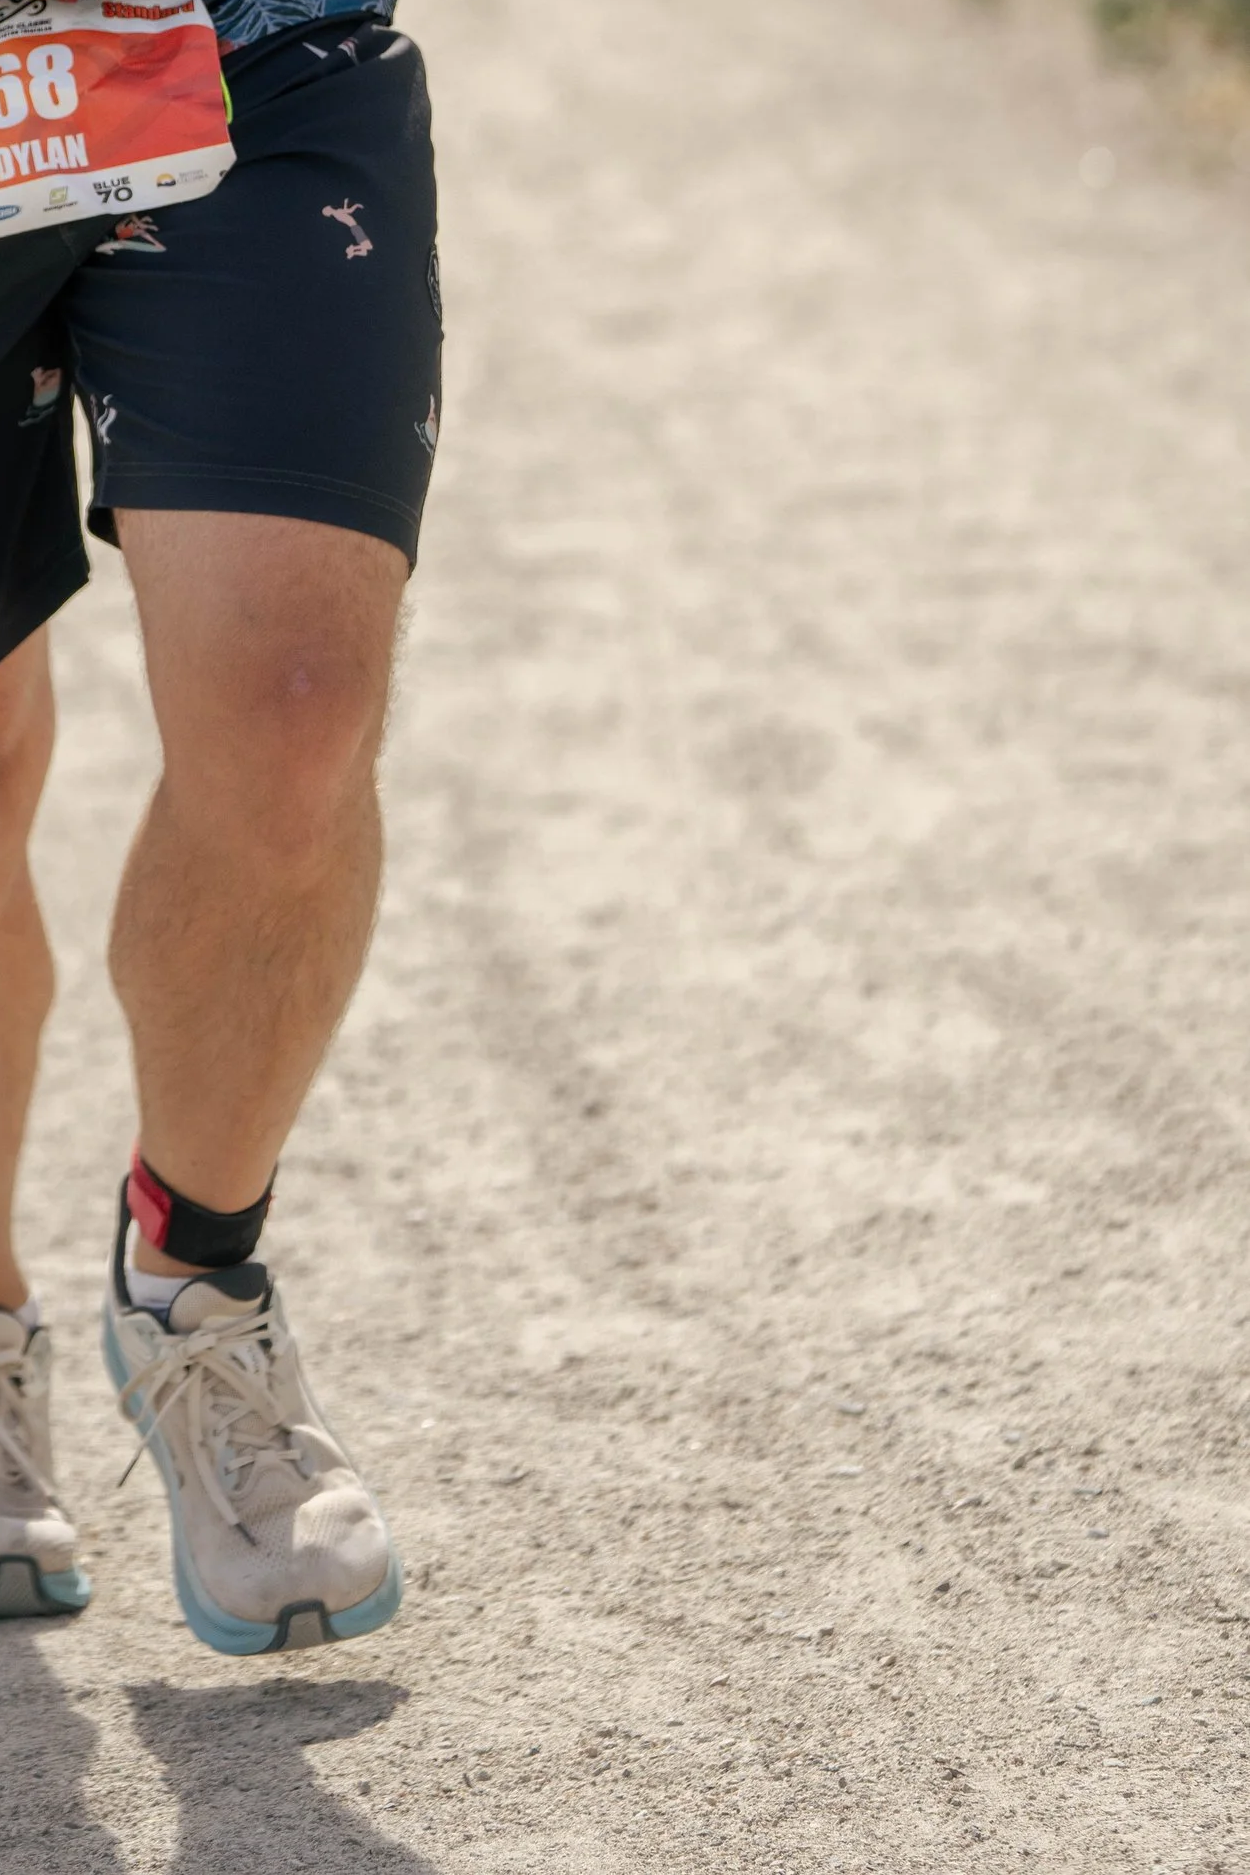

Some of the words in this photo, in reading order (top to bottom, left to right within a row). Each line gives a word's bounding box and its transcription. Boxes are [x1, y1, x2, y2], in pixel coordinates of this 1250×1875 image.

[102, 1, 194, 20] Standard
[92, 176, 131, 190] BLUE
[96, 187, 133, 204] 70
